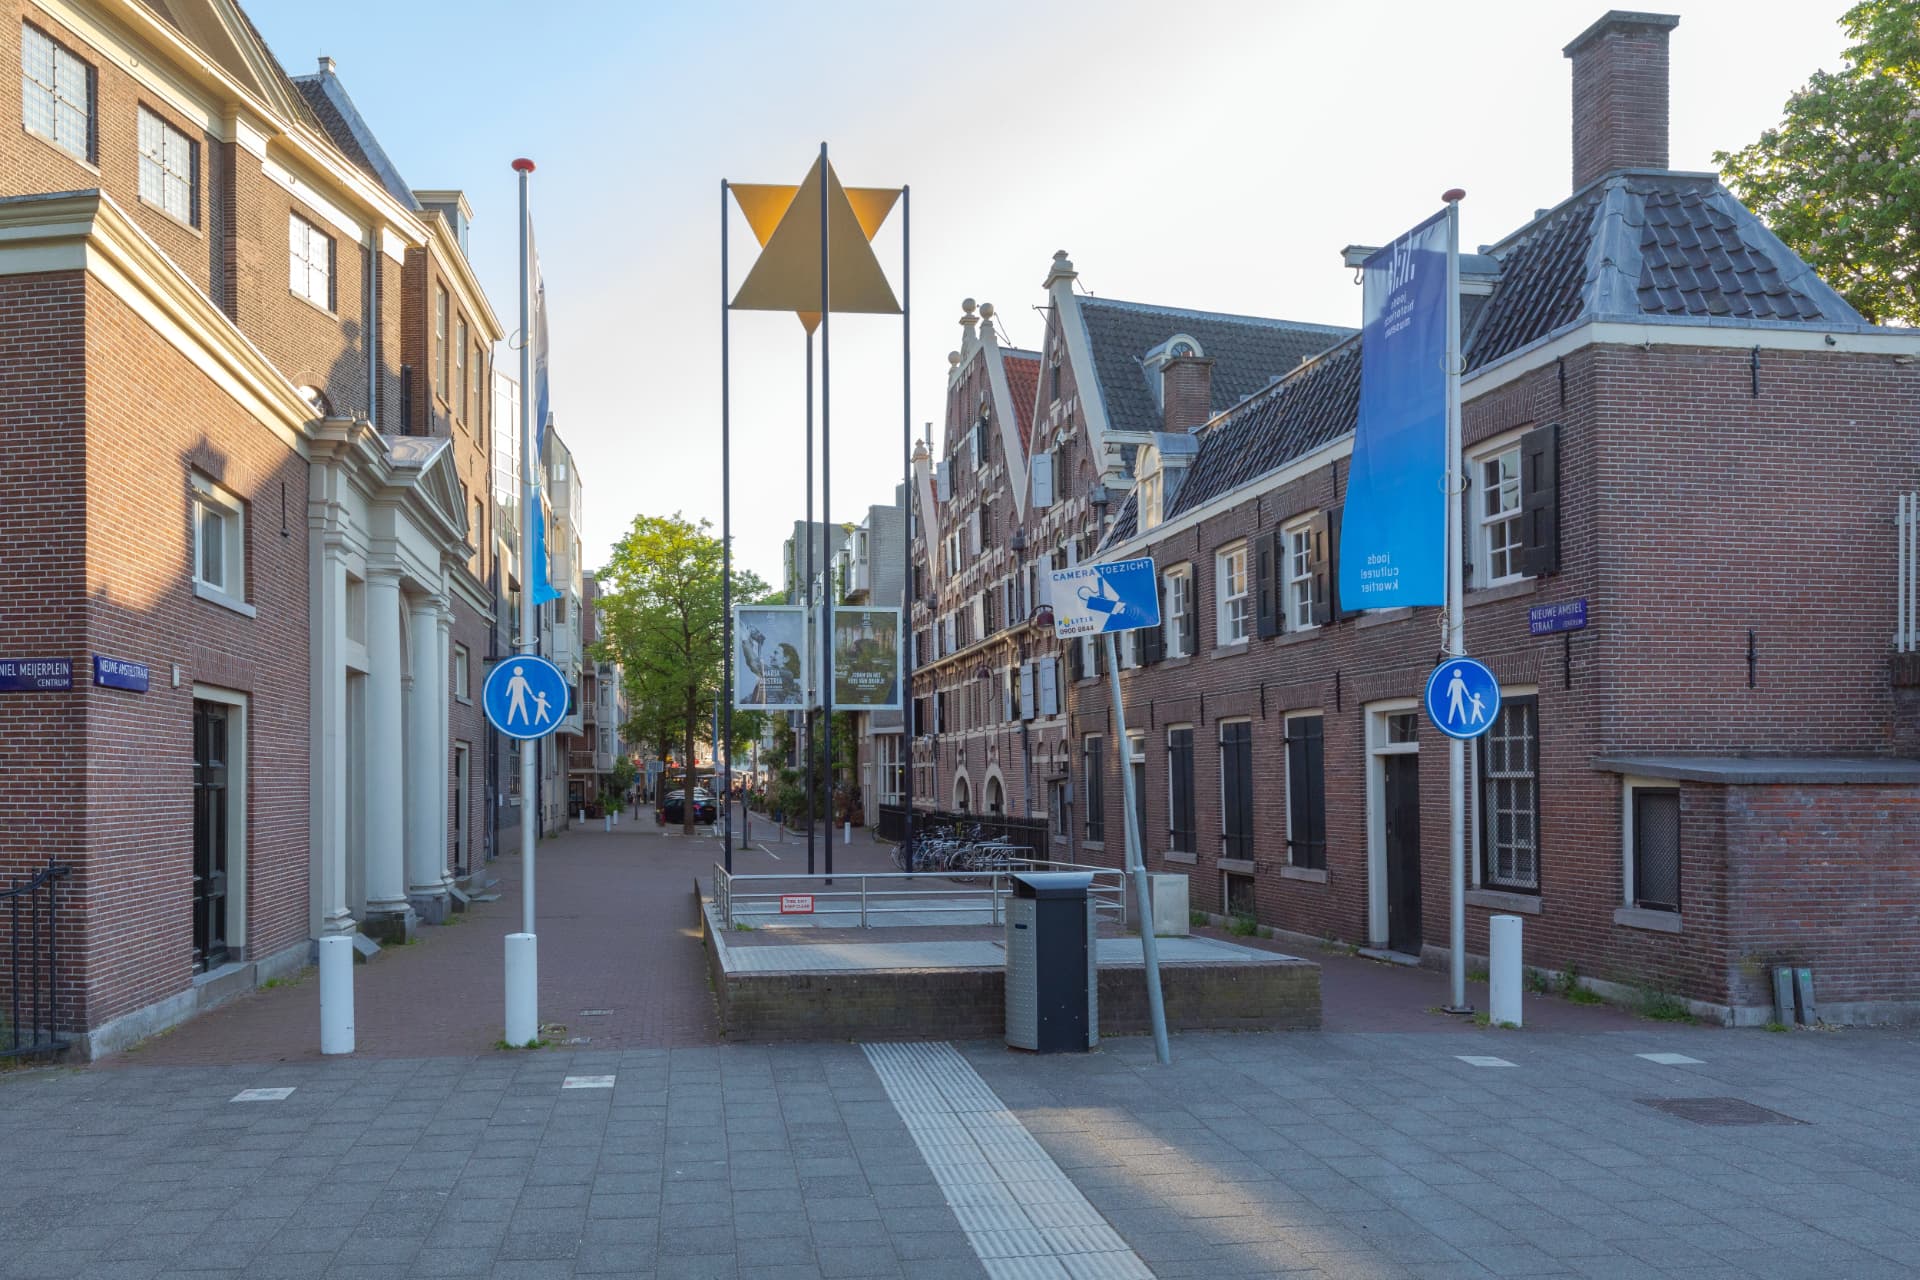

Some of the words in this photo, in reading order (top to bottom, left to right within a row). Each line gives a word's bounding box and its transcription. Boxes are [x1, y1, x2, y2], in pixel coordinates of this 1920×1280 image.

[1053, 569, 1095, 582] CAMERA
[1099, 560, 1151, 575] TOEZICHT
[1531, 606, 1557, 621] NIEUWE
[1557, 602, 1583, 616] AMSTEL
[1059, 627, 1076, 635] 0900
[1531, 620, 1554, 633] STRAAT
[19, 662, 69, 679] MEIJERPLEIN
[99, 659, 118, 675] NIEUWE
[118, 663, 149, 680] AMSTELSTRAAT
[37, 678, 69, 687] CENTRUM
